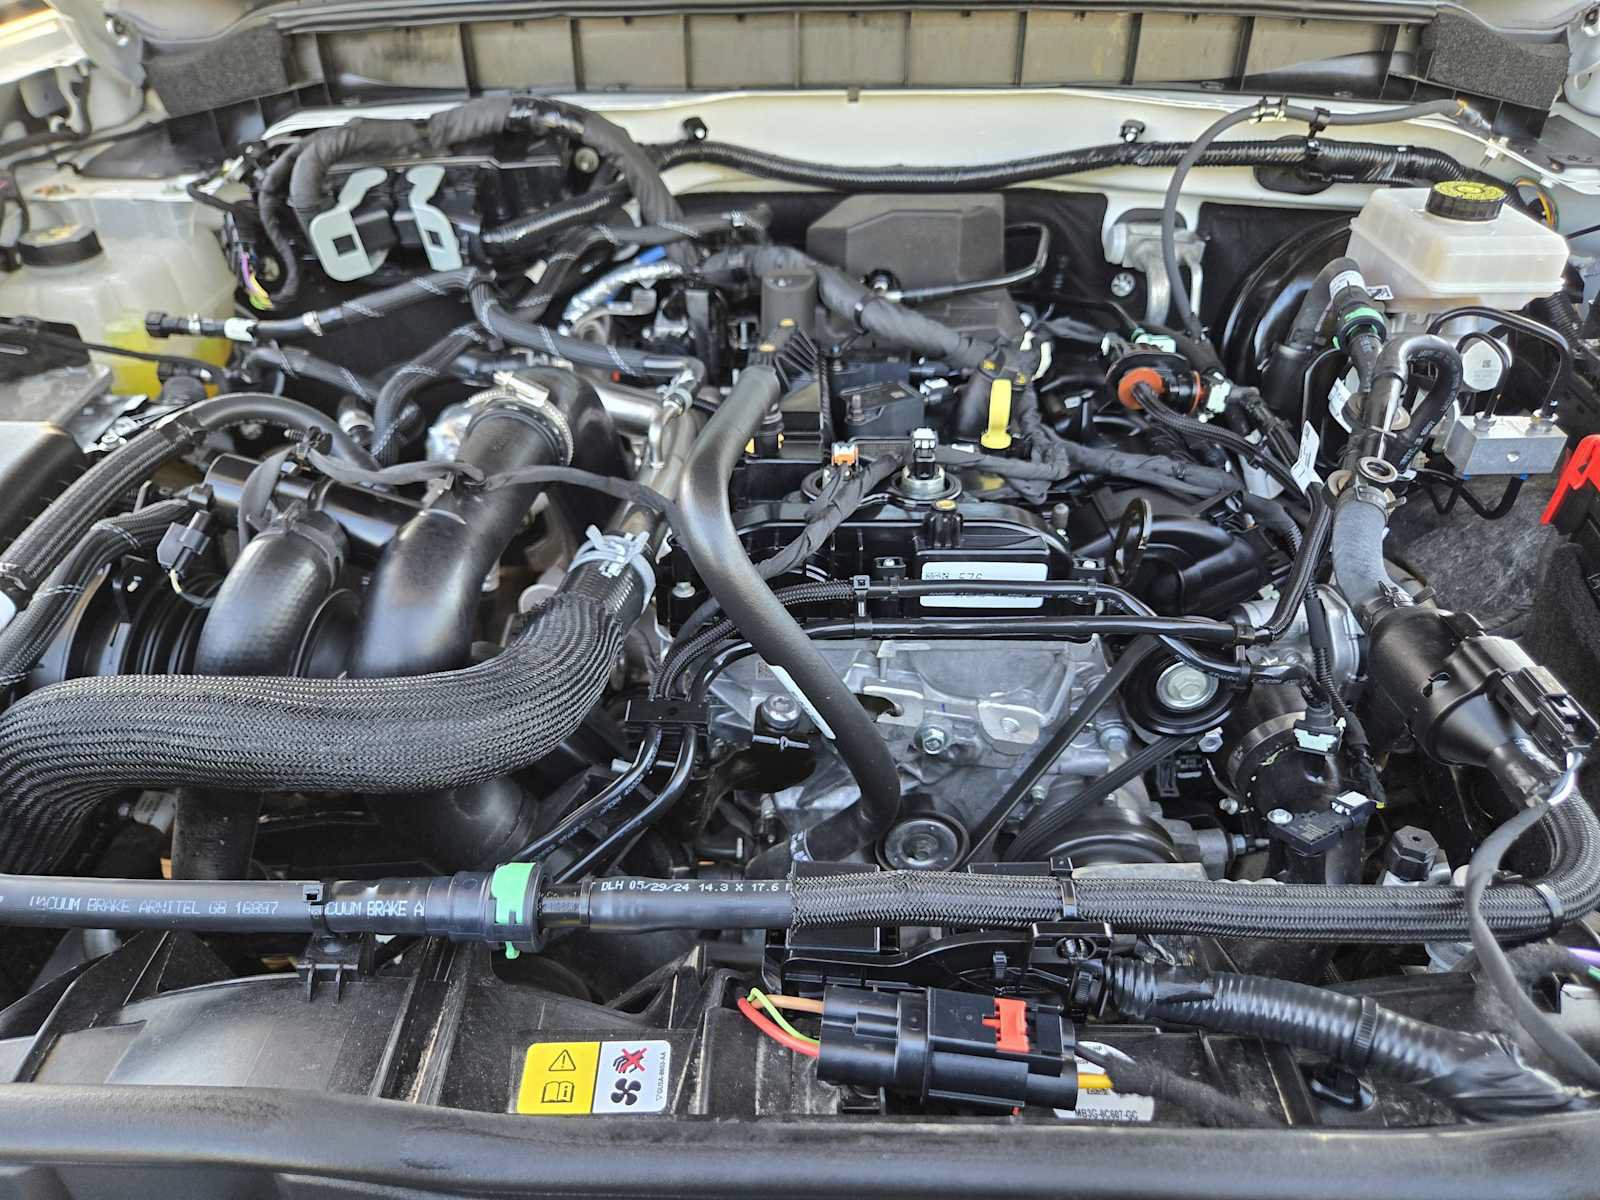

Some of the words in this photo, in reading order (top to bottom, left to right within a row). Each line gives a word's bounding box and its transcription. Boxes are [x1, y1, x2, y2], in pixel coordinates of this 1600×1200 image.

[600, 879, 625, 892] DLH
[628, 880, 690, 893] 05/29/24
[698, 882, 730, 893] 14.3
[751, 881, 780, 893] 17.6
[87, 897, 130, 913] BRAKE
[366, 900, 409, 917] BRAKE
